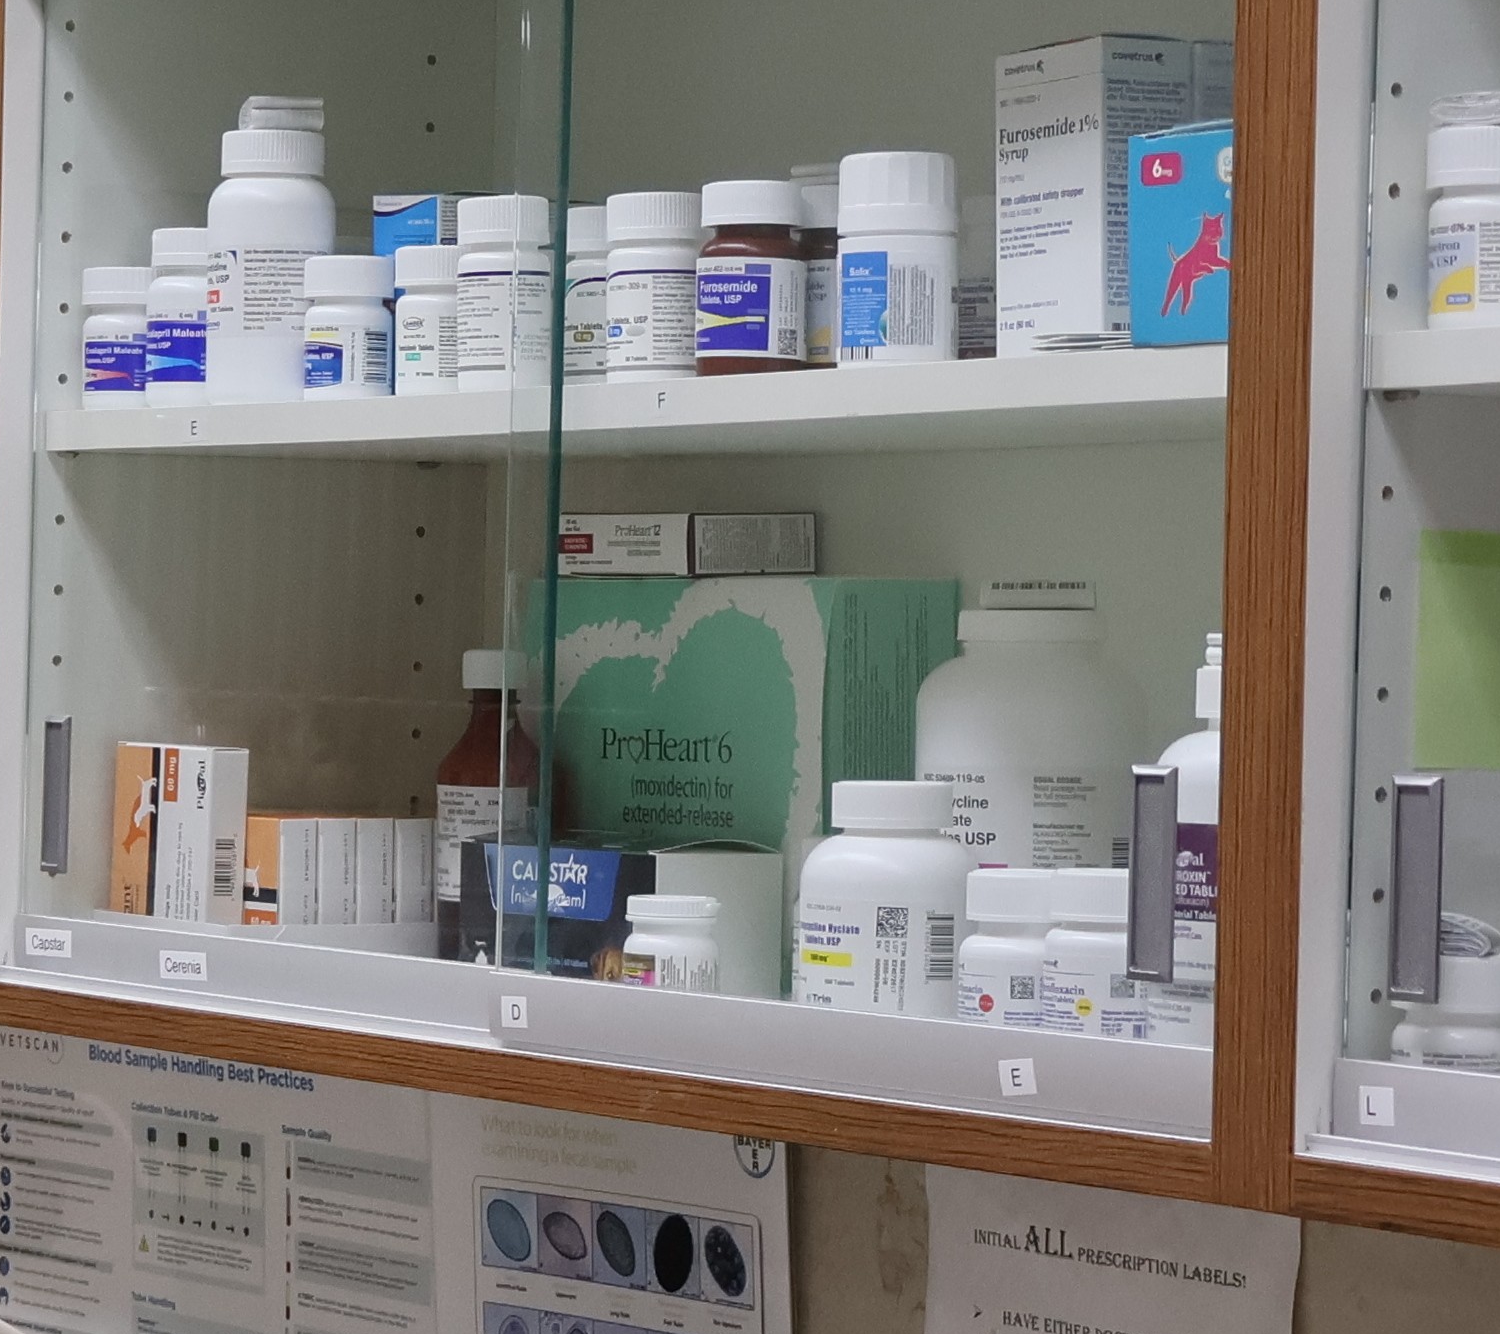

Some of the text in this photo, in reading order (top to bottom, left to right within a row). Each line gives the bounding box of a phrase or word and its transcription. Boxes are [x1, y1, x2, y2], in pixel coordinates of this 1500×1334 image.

[1111, 50, 1154, 63] covetrus
[999, 112, 1099, 146] Furosemide 1%
[998, 146, 1029, 165] Syrup
[1151, 158, 1162, 178] 6
[215, 273, 230, 285] USP
[700, 280, 758, 294] Furosemide
[723, 294, 742, 305] USP
[633, 315, 649, 324] USP
[657, 391, 666, 409] F
[190, 419, 198, 436] E
[717, 732, 733, 764] 6
[630, 773, 734, 800] (moxidectin) for
[622, 803, 734, 828] extended-release
[964, 832, 997, 846] USP
[31, 933, 67, 954] Capstar
[164, 957, 202, 975] Cerenia
[511, 1003, 522, 1021] D
[0, 1032, 60, 1054] VETSCAN
[88, 1043, 316, 1092] Blood Sample Handling Best Practices
[1010, 1067, 1022, 1087] E
[1365, 1095, 1377, 1117] L
[281, 1123, 333, 1144] Sample Quality
[737, 1134, 772, 1151] BAYER
[973, 1224, 1248, 1289] INITIAL ALL PRESCRIPTION LABELS!
[1002, 1310, 1040, 1332] HAVE
